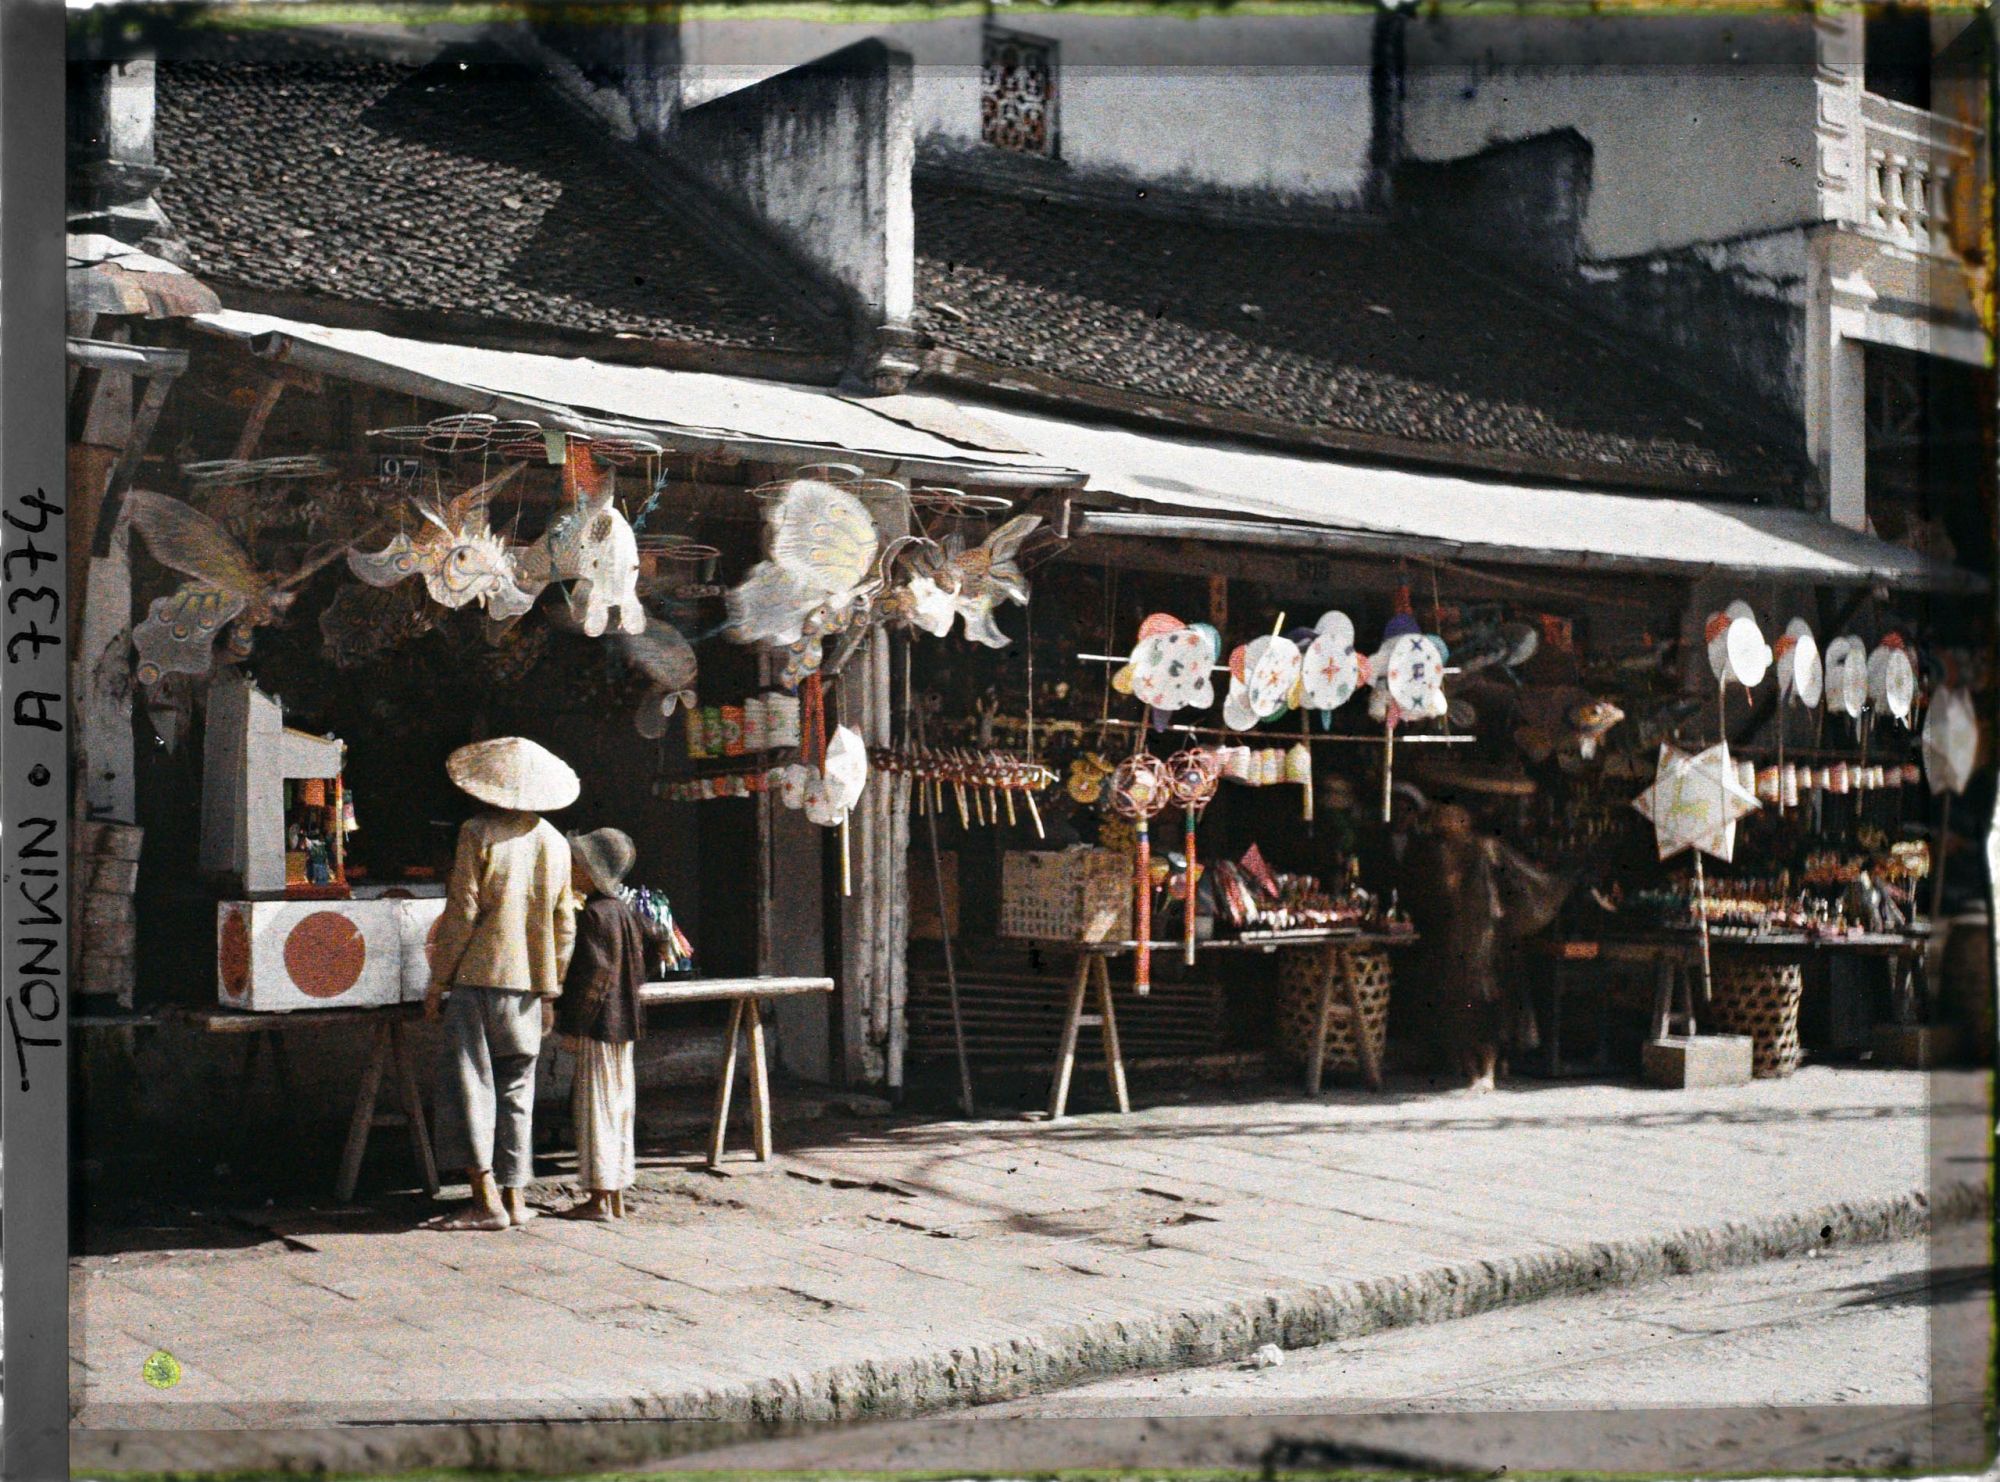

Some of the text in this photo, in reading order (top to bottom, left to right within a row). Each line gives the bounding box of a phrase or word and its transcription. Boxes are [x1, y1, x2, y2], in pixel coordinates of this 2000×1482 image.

[3, 487, 64, 1092] TONKIN A 7374
